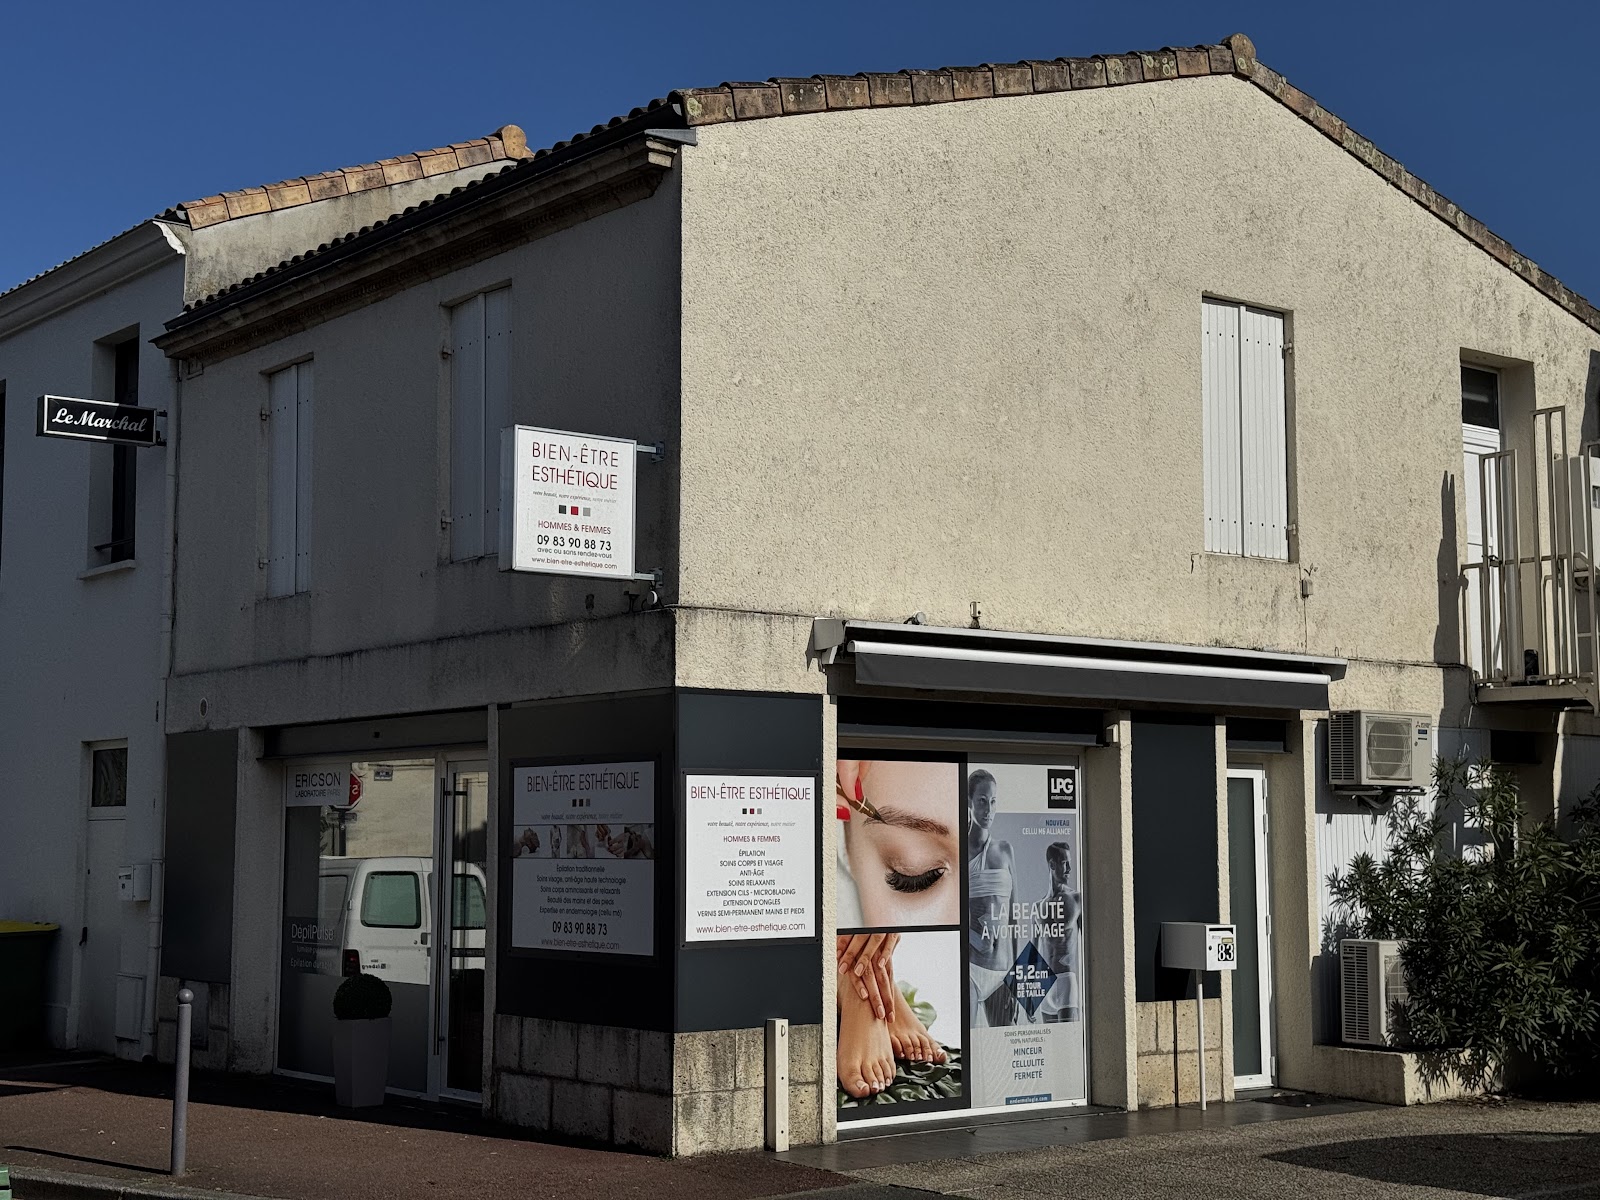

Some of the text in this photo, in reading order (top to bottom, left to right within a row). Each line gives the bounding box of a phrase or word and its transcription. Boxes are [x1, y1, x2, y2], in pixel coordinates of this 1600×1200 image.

[52, 408, 148, 432] Le Marchal
[532, 442, 618, 467] BIEN-ÊTRE
[532, 465, 617, 490] ESTHÉTIQUE
[538, 520, 572, 531] HOMMES
[581, 524, 611, 535] FEMMES
[537, 534, 612, 551] 09 83 90 88 73
[578, 550, 612, 559] rendez-vous
[532, 557, 617, 570] www.bien-etre-esthetique.com
[295, 772, 341, 788] ERICSON
[527, 768, 640, 792] BIEN-ÊTRE ESTHÉTIQUE
[690, 782, 811, 800] BIEN-ÊTRE ESTHÉTIQUE
[1050, 778, 1074, 794] LPG
[295, 788, 326, 798] LABORATOIRE
[327, 789, 341, 797] PARIS
[747, 820, 770, 828] expérience,
[1046, 819, 1070, 827] NOUVEAU
[1022, 827, 1038, 835] CELLU
[723, 835, 750, 843] HOMMES
[757, 835, 781, 843] FEMMES
[739, 849, 766, 857] ÉPILATION
[576, 865, 605, 873] traditionnelle
[740, 869, 764, 877] ANTI-ÂGE
[565, 876, 583, 885] anti-âge
[584, 876, 597, 884] haute
[598, 877, 626, 886] technologie
[599, 887, 621, 895] relaxants
[754, 888, 796, 896] MICROBLADING
[547, 896, 562, 904] Beauté
[592, 897, 601, 905] des
[601, 898, 614, 906] pieds
[753, 898, 781, 906] D'ONGLES
[539, 906, 558, 914] Expertise
[566, 907, 598, 916] endermologie
[717, 909, 764, 917] SEMI-PERMANENT
[991, 896, 1064, 920] LA BEAUTÉ
[291, 924, 334, 942] DépilPulse
[552, 921, 608, 936] 09 83 90 88 73
[696, 922, 806, 934] www.bien-etre-esthetique.com
[981, 921, 1065, 940] À VOTRE IMAGE
[541, 938, 620, 950] www.bien-etre-esthetique.com
[1218, 944, 1234, 960] 83
[1017, 982, 1041, 990] DE TOUR
[1017, 989, 1045, 998] DE TAILLE
[1018, 1028, 1051, 1037] PERSONNALISÉS
[1014, 1046, 1042, 1056] MINCEUR
[1012, 1058, 1045, 1068] CELLULITE
[1014, 1069, 1042, 1080] FERMETÉ
